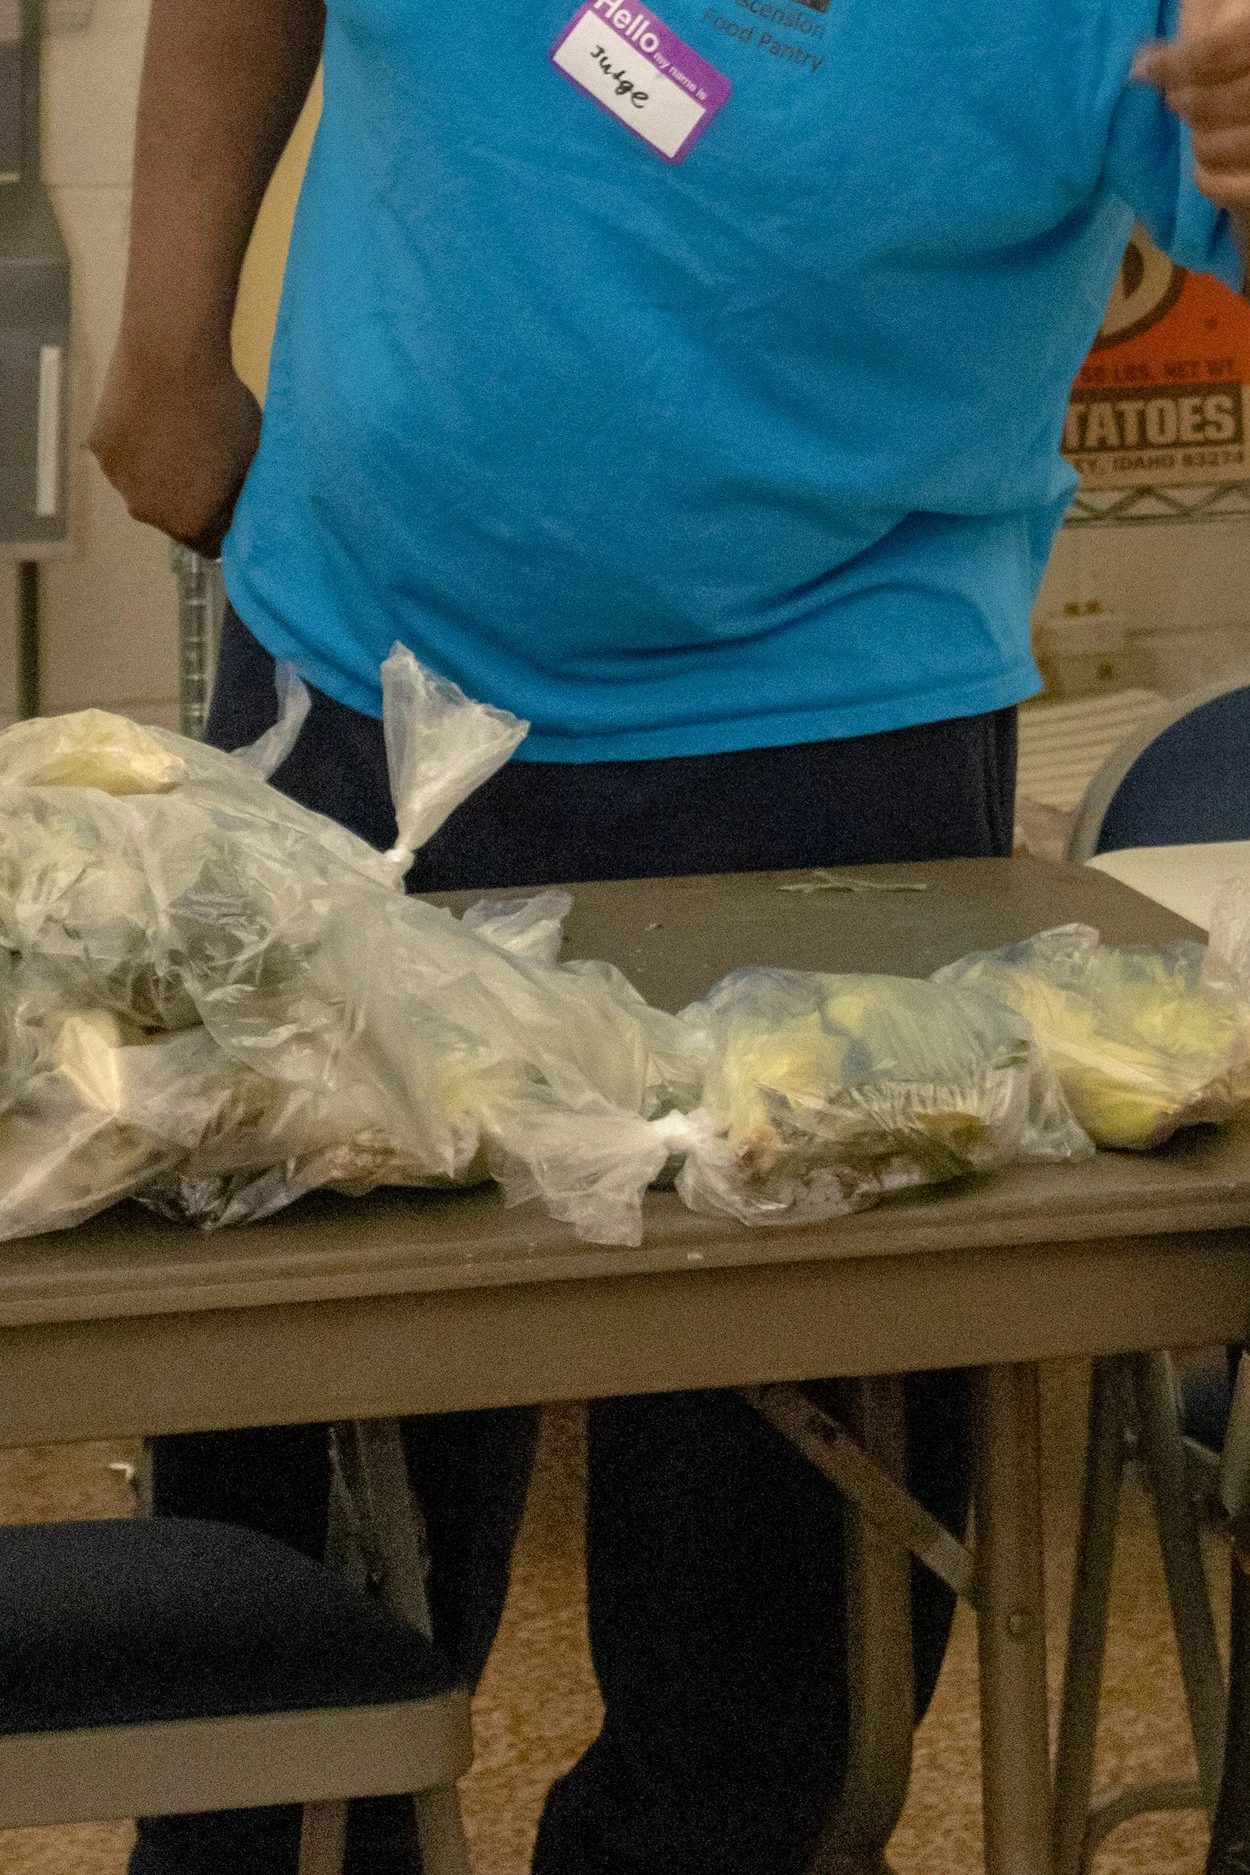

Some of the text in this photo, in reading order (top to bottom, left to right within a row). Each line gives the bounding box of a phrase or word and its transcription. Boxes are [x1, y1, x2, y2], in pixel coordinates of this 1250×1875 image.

[702, 7, 825, 72] Food Pantry
[653, 51, 671, 69] my
[668, 66, 698, 93] name
[1112, 454, 1176, 471] IDAHO
